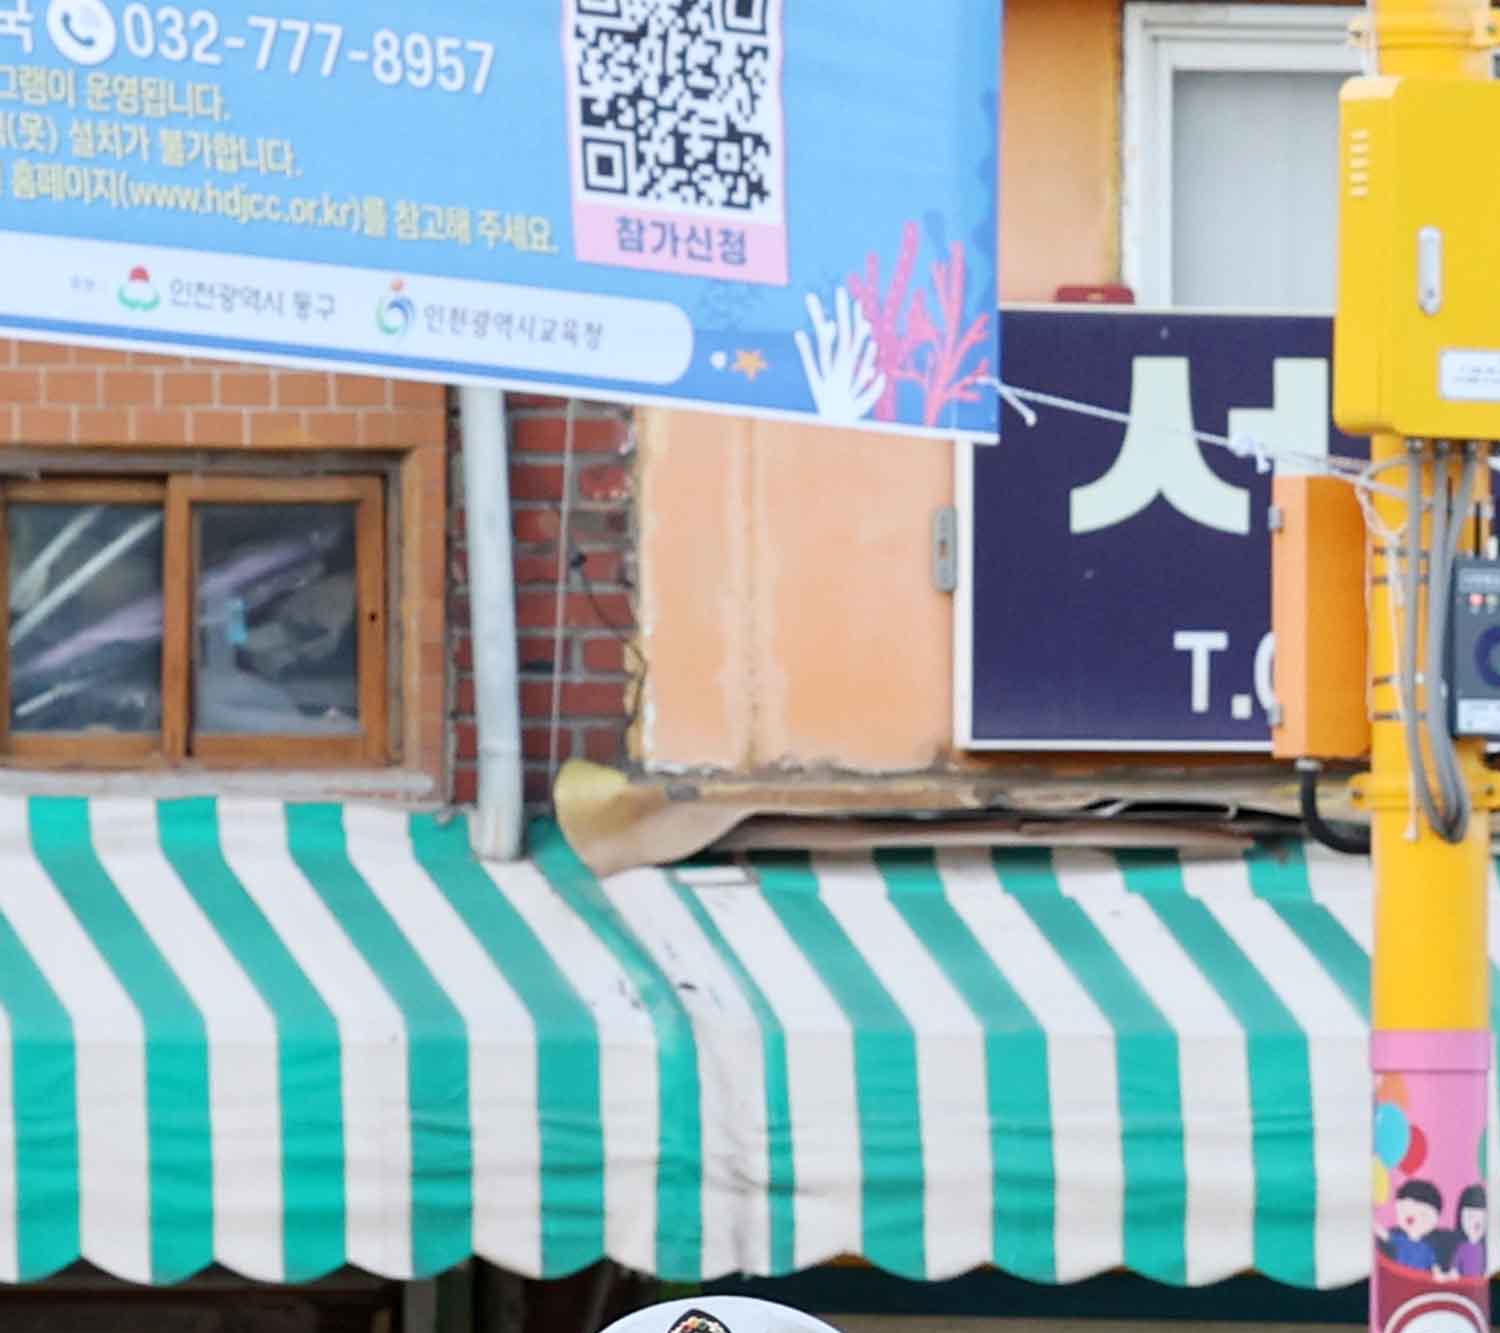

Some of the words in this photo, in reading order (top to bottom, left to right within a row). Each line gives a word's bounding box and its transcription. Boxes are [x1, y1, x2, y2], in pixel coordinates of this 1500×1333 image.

[122, 3, 495, 95] 032-777-8957
[87, 71, 231, 120] 운영됩니다.
[159, 129, 304, 177] 불가합니다.
[616, 215, 748, 266] 참가신청
[168, 278, 287, 318] 인천광역시
